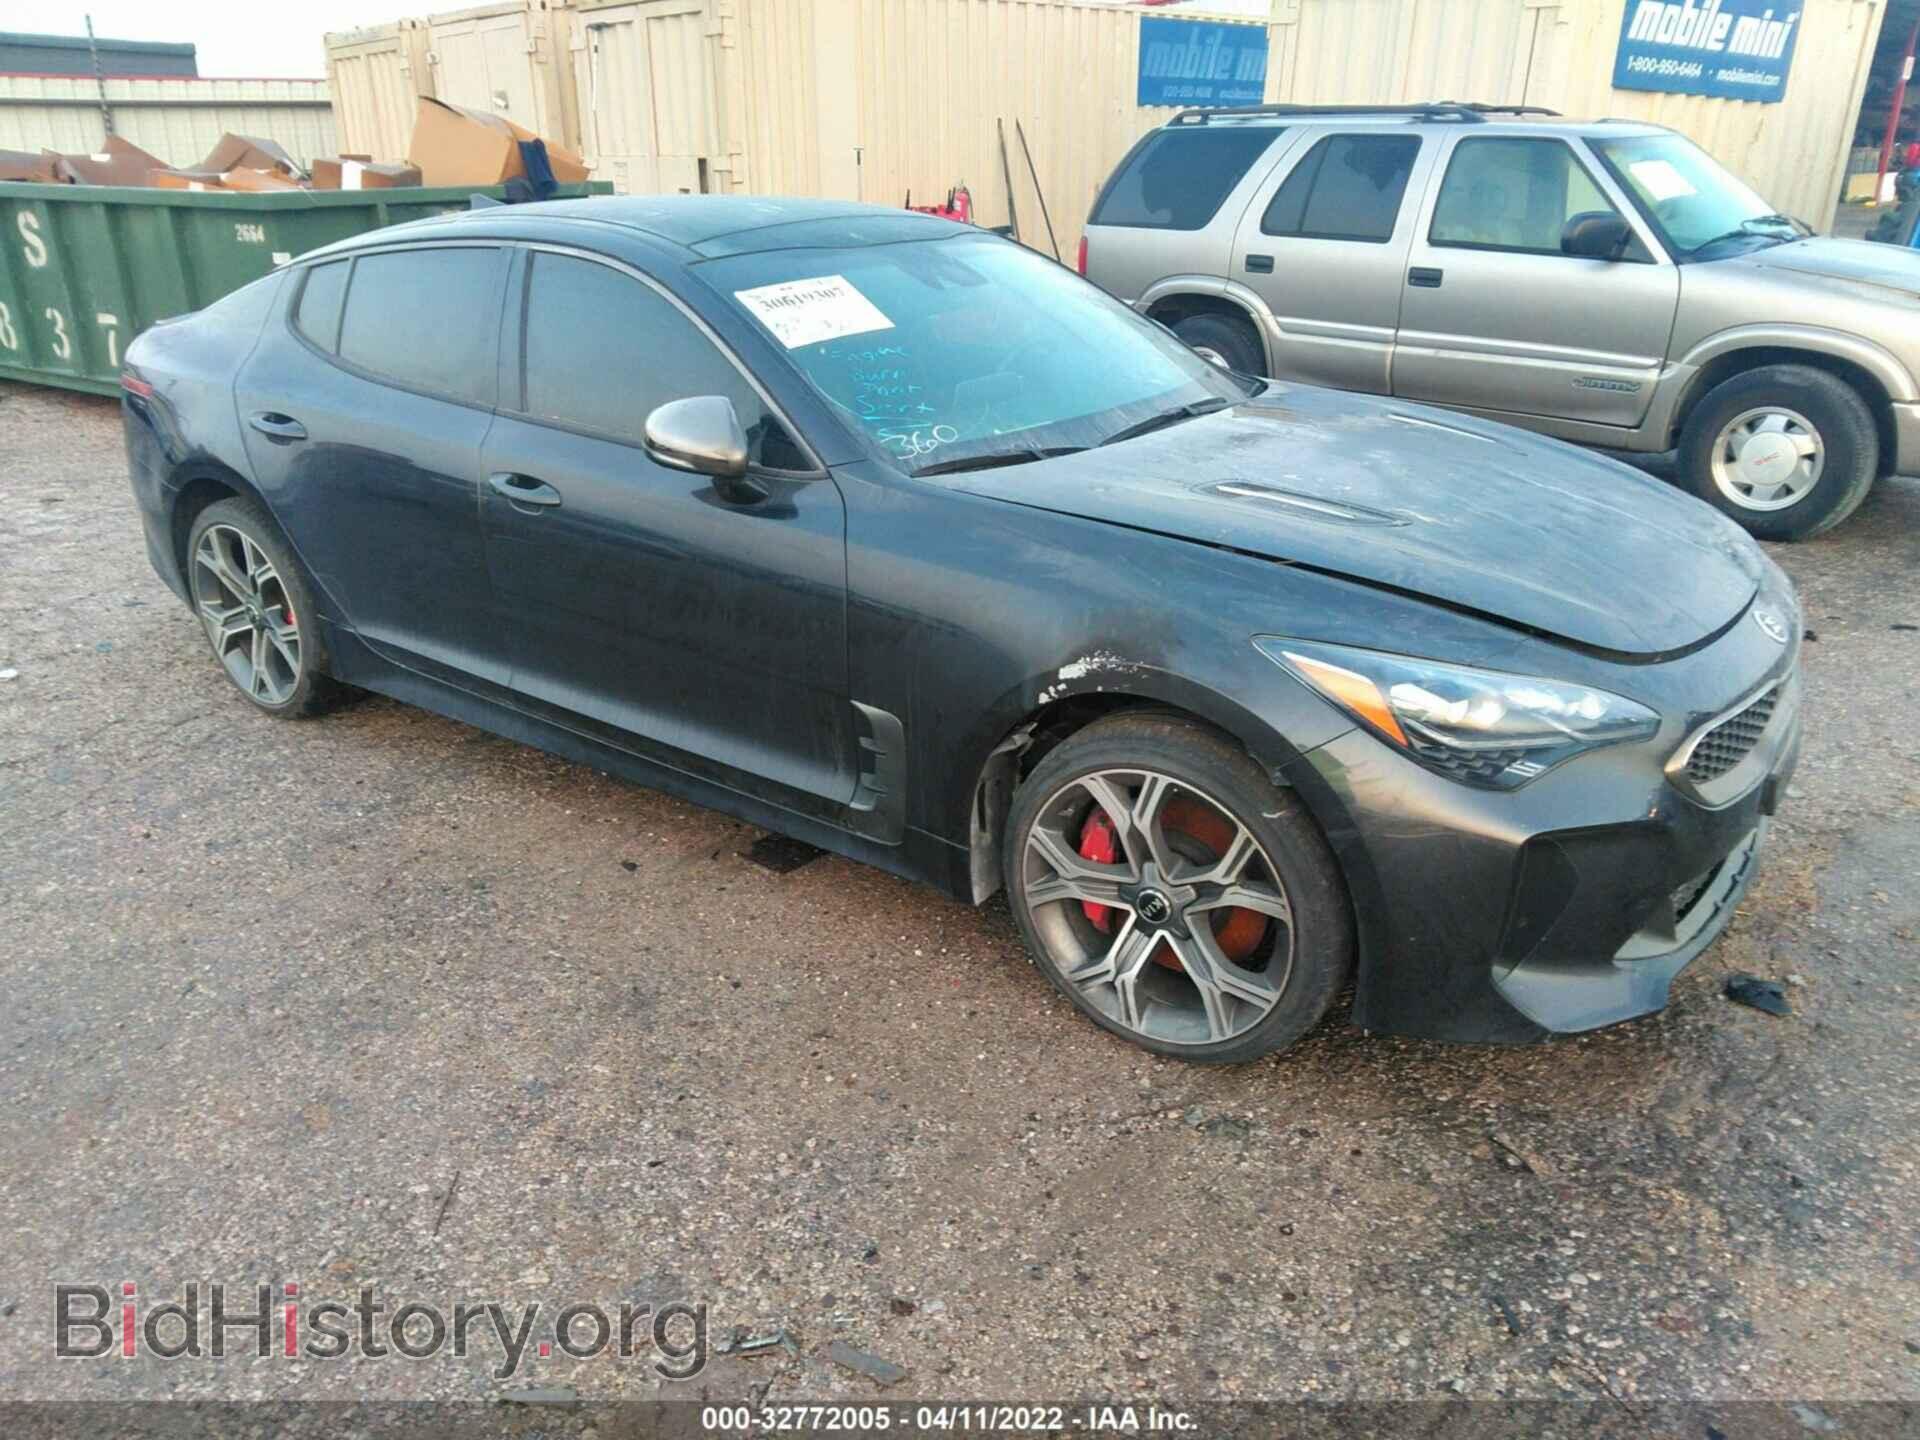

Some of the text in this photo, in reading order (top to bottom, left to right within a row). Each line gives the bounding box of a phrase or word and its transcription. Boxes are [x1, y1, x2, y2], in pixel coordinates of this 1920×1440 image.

[1142, 25, 1233, 79] mobile
[1627, 0, 1800, 59] mobile mini
[17, 211, 48, 267] S
[880, 424, 959, 460] 360
